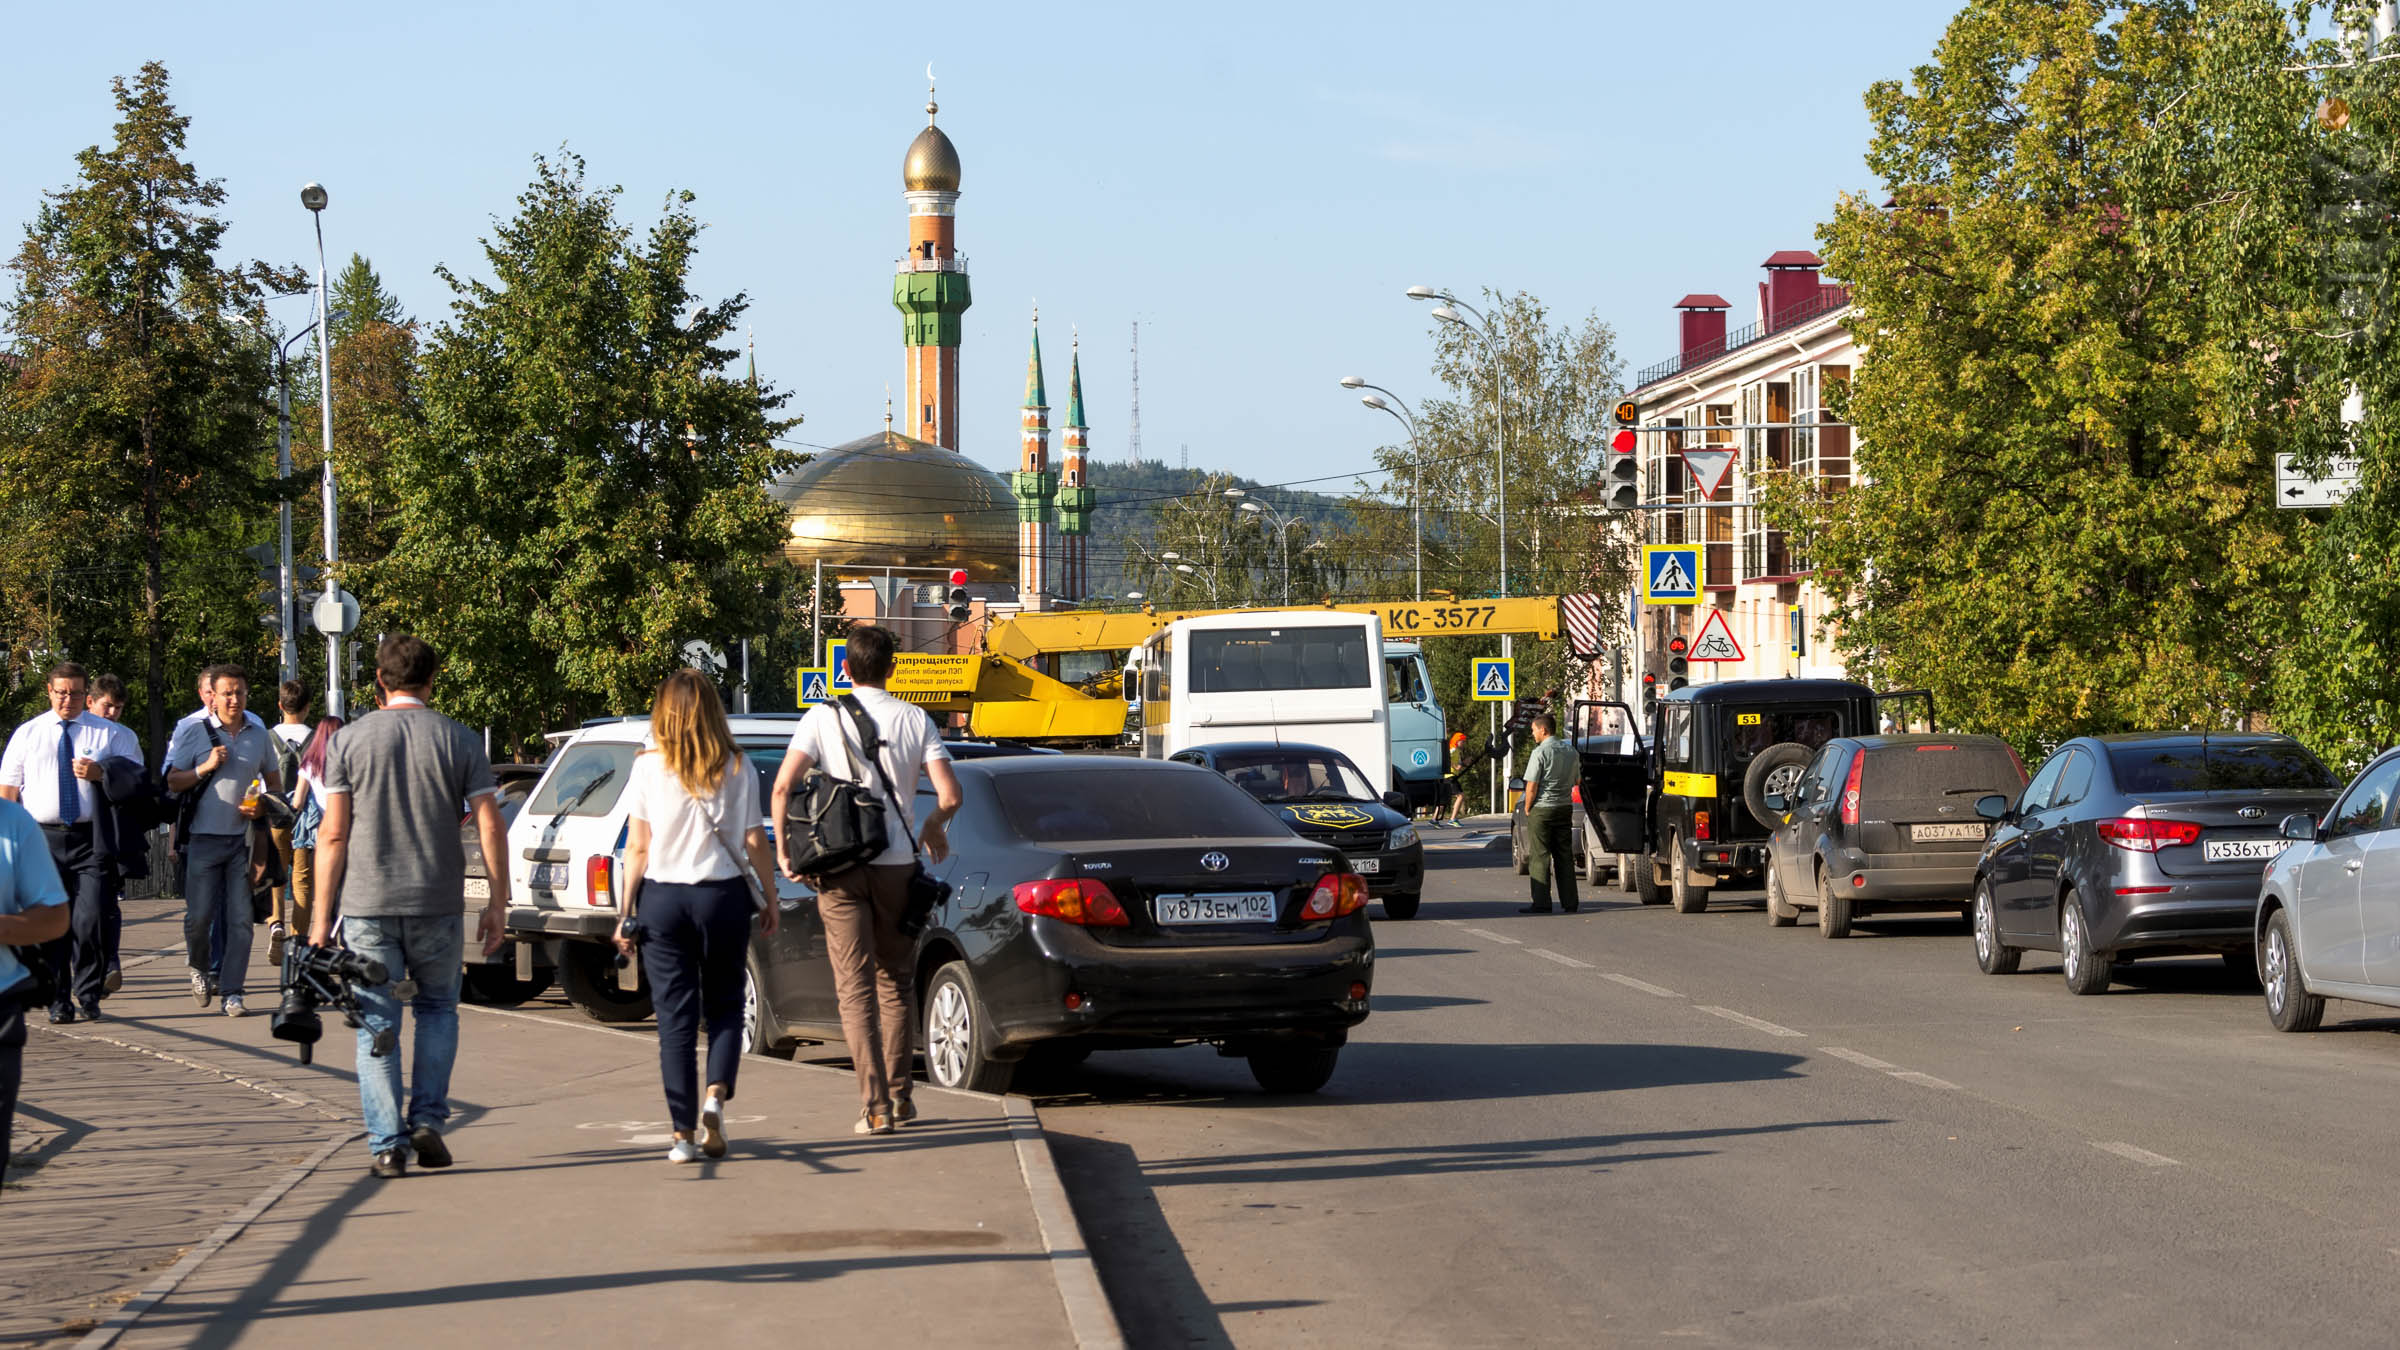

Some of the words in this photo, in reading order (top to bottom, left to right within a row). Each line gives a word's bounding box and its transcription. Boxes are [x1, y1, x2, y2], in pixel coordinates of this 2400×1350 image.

[1616, 404, 1633, 420] 40
[1389, 606, 1496, 630] КС-3577
[893, 657, 968, 666] Запрещается
[896, 668, 920, 676] работа
[1743, 715, 1756, 723] 53
[2244, 808, 2263, 818] KIA
[1917, 824, 1962, 839] А037УА
[1964, 825, 1981, 834] 116
[2213, 842, 2271, 857] Х536ХТ
[1361, 860, 1377, 869] 116
[1167, 899, 1239, 919] У873ЕМ
[1241, 896, 1268, 912] 102
